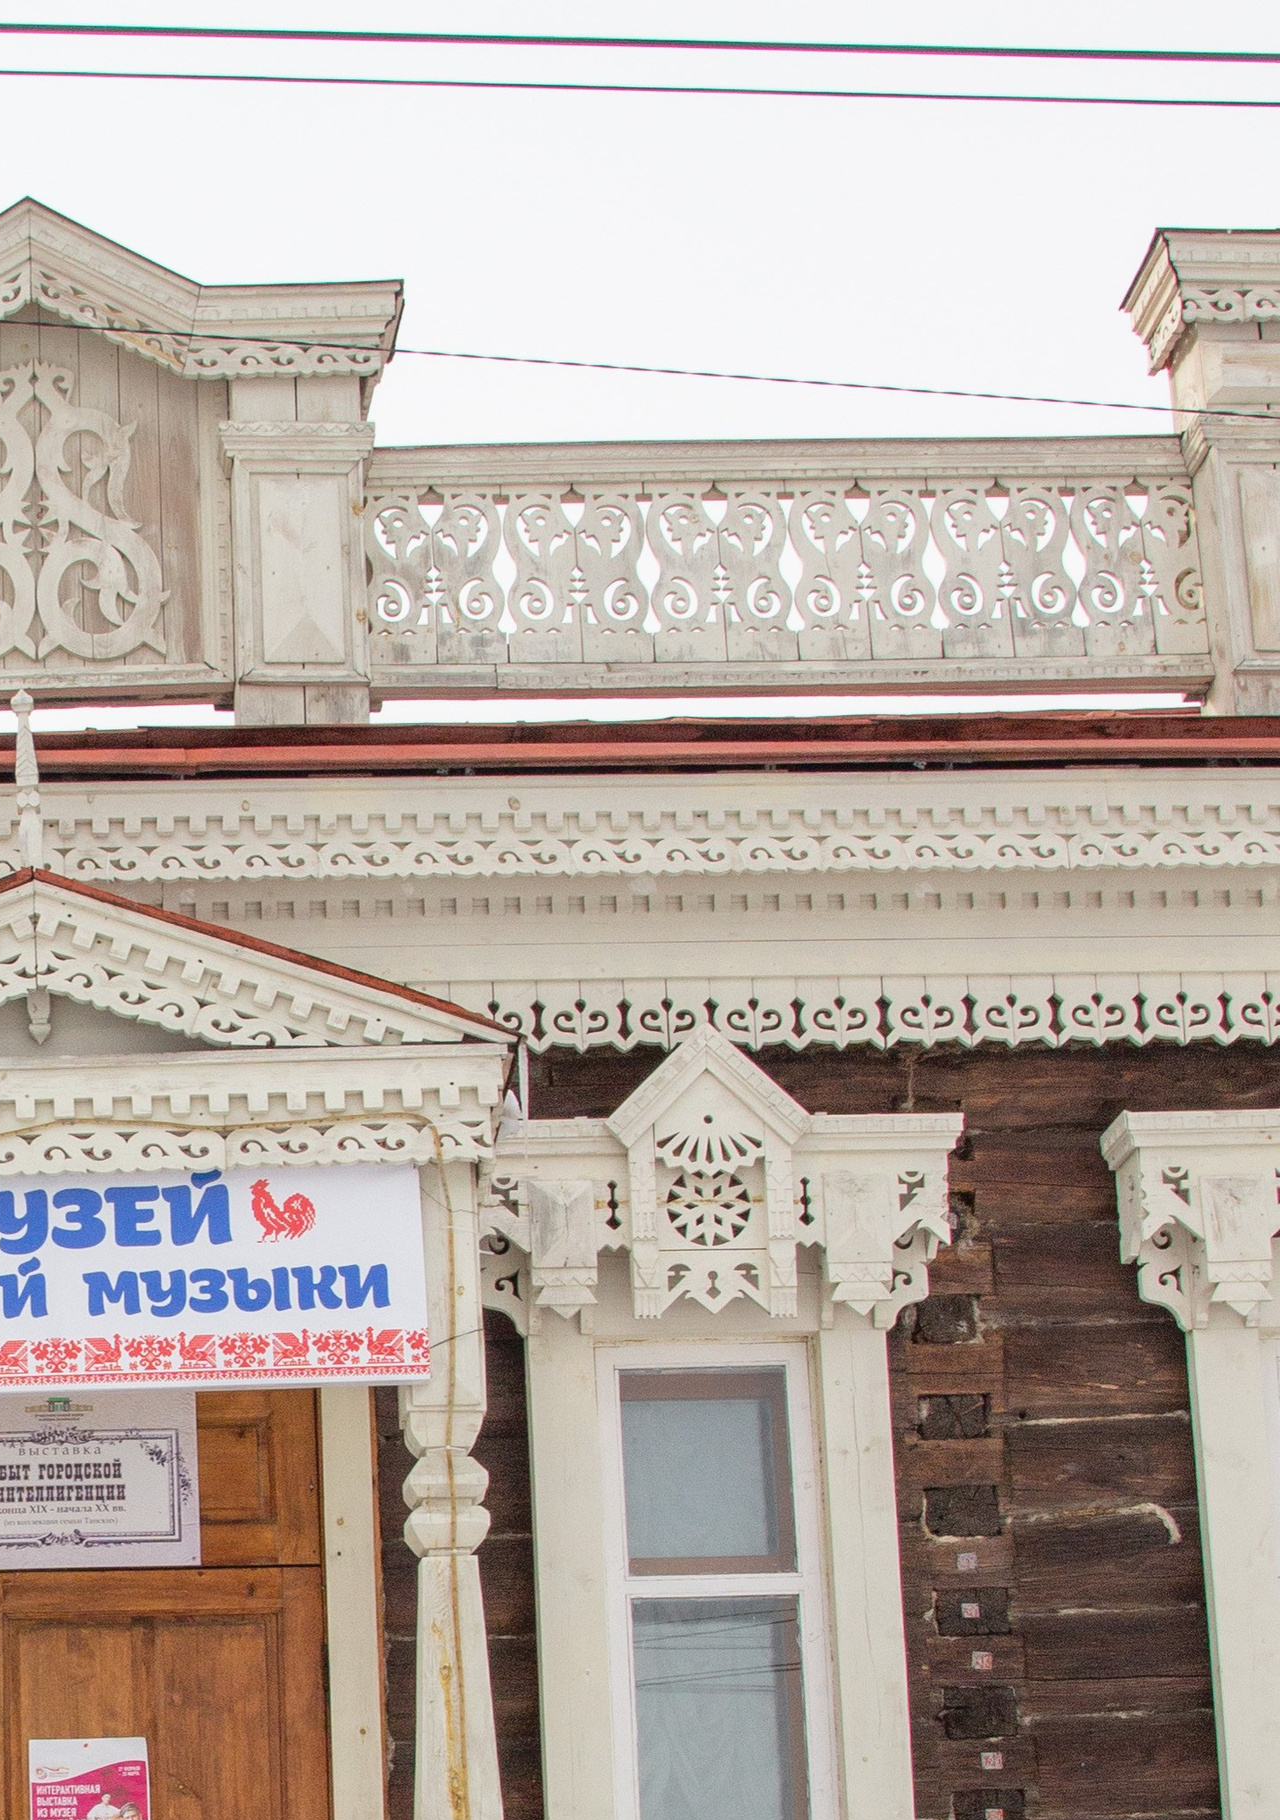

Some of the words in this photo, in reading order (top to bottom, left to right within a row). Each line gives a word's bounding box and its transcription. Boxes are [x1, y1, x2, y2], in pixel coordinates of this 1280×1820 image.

[82, 1263, 391, 1318] МУЗЫКИ
[38, 1458, 122, 1482] ГОРОДСКОЙ
[29, 1505, 49, 1514] XIX
[56, 1505, 93, 1513] начала
[95, 1504, 110, 1512] XX
[112, 1505, 127, 1513] вв.
[36, 1784, 101, 1795] ИНТЕРАКТИВНАЯ
[36, 1796, 78, 1806] ВЫСТАВКА
[37, 1808, 48, 1817] ИЗ
[50, 1808, 77, 1817] МУЗЕЯ
